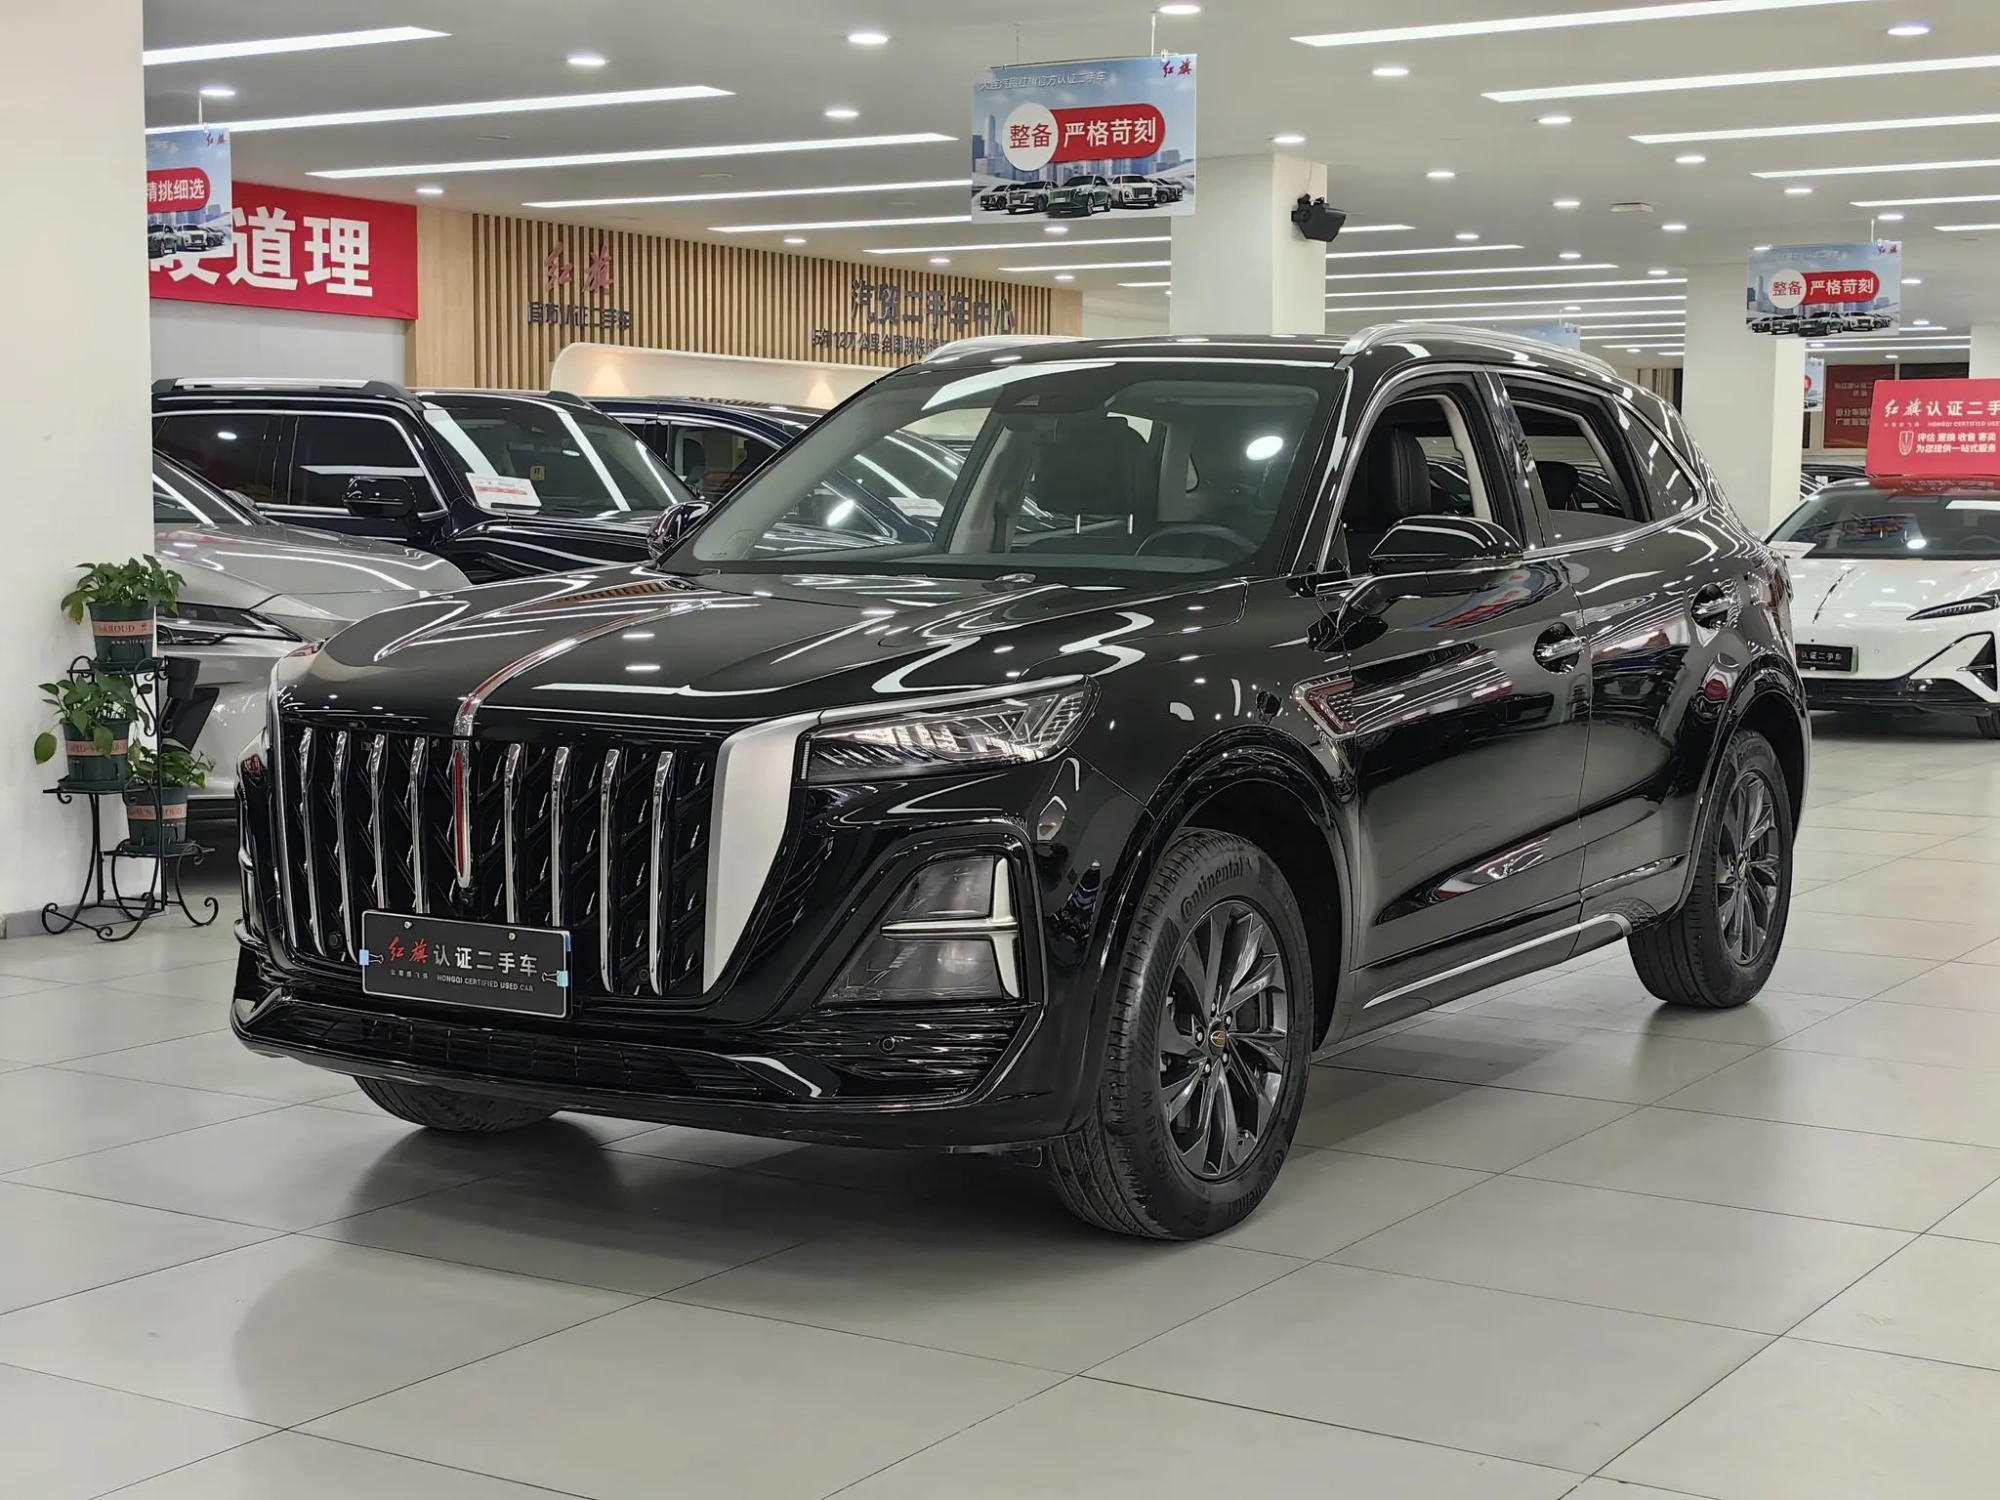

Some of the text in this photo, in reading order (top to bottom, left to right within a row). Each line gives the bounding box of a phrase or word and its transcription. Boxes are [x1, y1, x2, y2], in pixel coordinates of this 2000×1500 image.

[1162, 58, 1192, 78] 红旗
[1009, 117, 1156, 149] 整备 严格苛刻
[1772, 277, 1874, 297] 整备 严格苛刻
[851, 279, 1015, 336] 汽贸二手车中心
[389, 936, 538, 977] 红旗认证二手车
[436, 974, 463, 984] HONGQI
[464, 977, 499, 988] CERTIFIED
